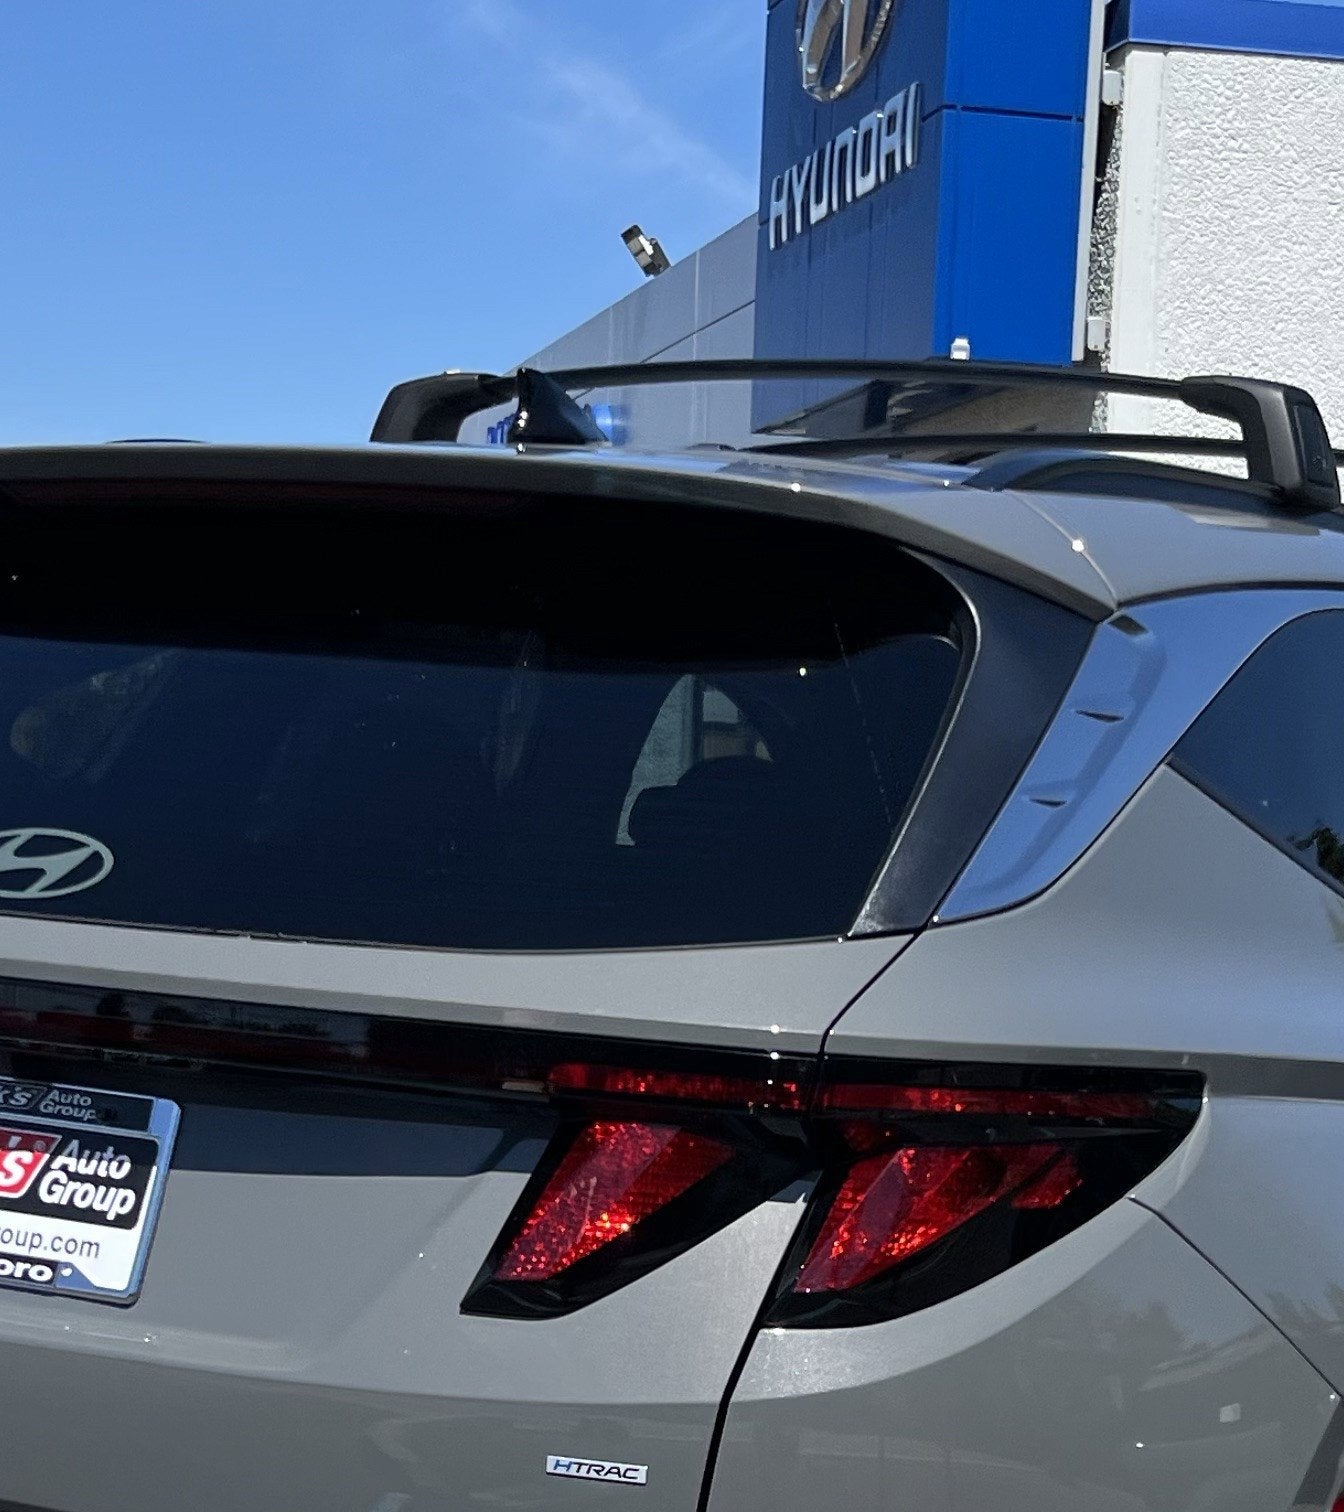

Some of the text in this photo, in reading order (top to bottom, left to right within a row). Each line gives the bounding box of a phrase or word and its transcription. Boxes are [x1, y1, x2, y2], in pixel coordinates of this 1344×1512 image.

[768, 80, 921, 251] HYUNDAI
[38, 1100, 97, 1122] Group
[46, 1090, 93, 1107] Auto
[50, 1138, 133, 1180] Auto
[39, 1169, 136, 1220] Group
[553, 1460, 639, 1480] HTRAC
